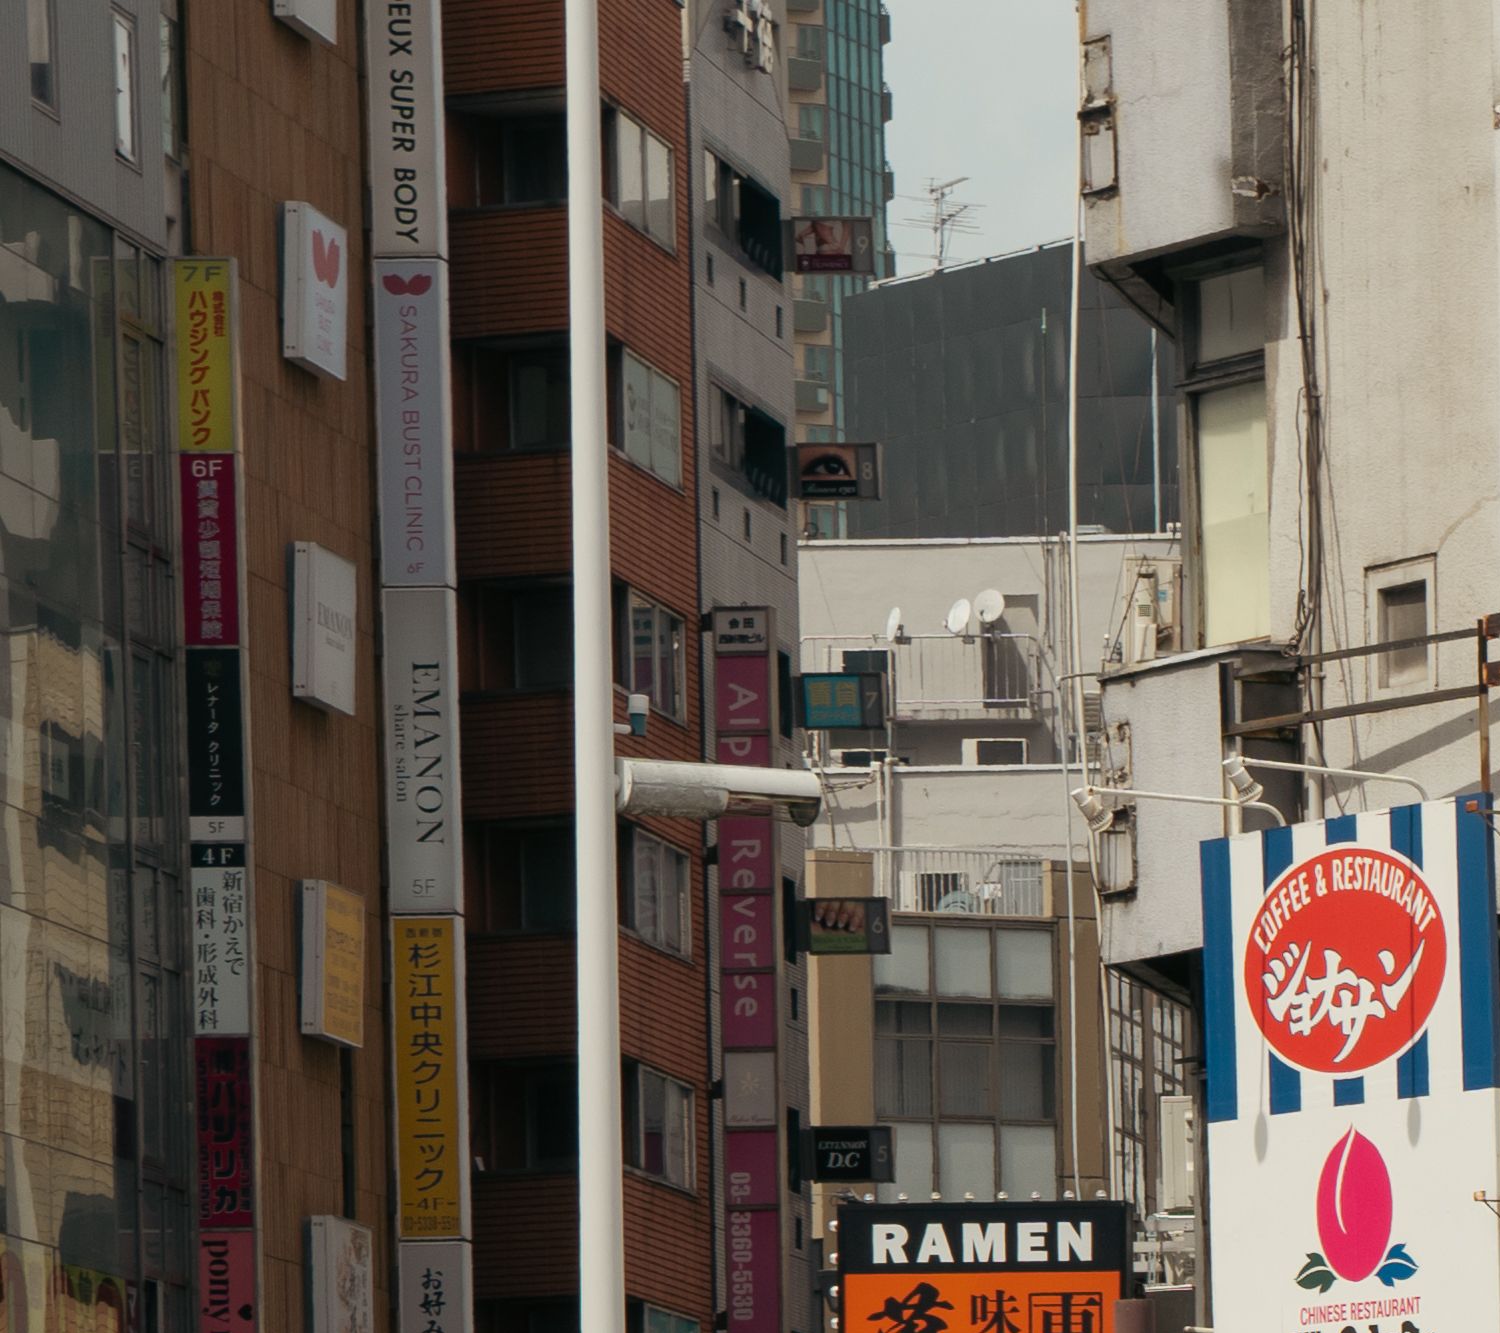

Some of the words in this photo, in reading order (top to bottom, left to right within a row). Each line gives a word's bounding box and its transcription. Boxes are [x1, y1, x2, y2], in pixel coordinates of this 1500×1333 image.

[390, 70, 415, 152] SUPER
[394, 167, 419, 244] BODY
[856, 236, 868, 255] 9
[182, 266, 221, 281] 7F
[399, 304, 420, 401] SAKURA
[402, 411, 421, 470] BUST
[191, 460, 222, 477] 6F
[862, 461, 874, 480] 8
[404, 476, 424, 552] CLINIC
[407, 562, 424, 573] 6F
[394, 704, 407, 750] share
[412, 661, 444, 845] EMANON
[397, 759, 411, 802] salon
[208, 822, 225, 833] 5F
[202, 849, 234, 864] 4F
[412, 879, 436, 894] 5F
[1252, 877, 1312, 955] COFFEE
[1316, 866, 1327, 894] &
[1331, 855, 1438, 935] RESTAURANT
[223, 869, 244, 978] 新宿かえで
[731, 839, 762, 1018] Reverse
[872, 916, 883, 934] 6
[1263, 937, 1428, 1064] ジョナサン
[408, 943, 445, 1193] 杉江中央クリニック
[877, 1147, 888, 1163] 5
[872, 1222, 1093, 1264] RAMEN
[202, 1239, 229, 1324] pony
[1300, 1300, 1350, 1326] CHINESE
[1350, 1296, 1421, 1321] RESTAURANT
